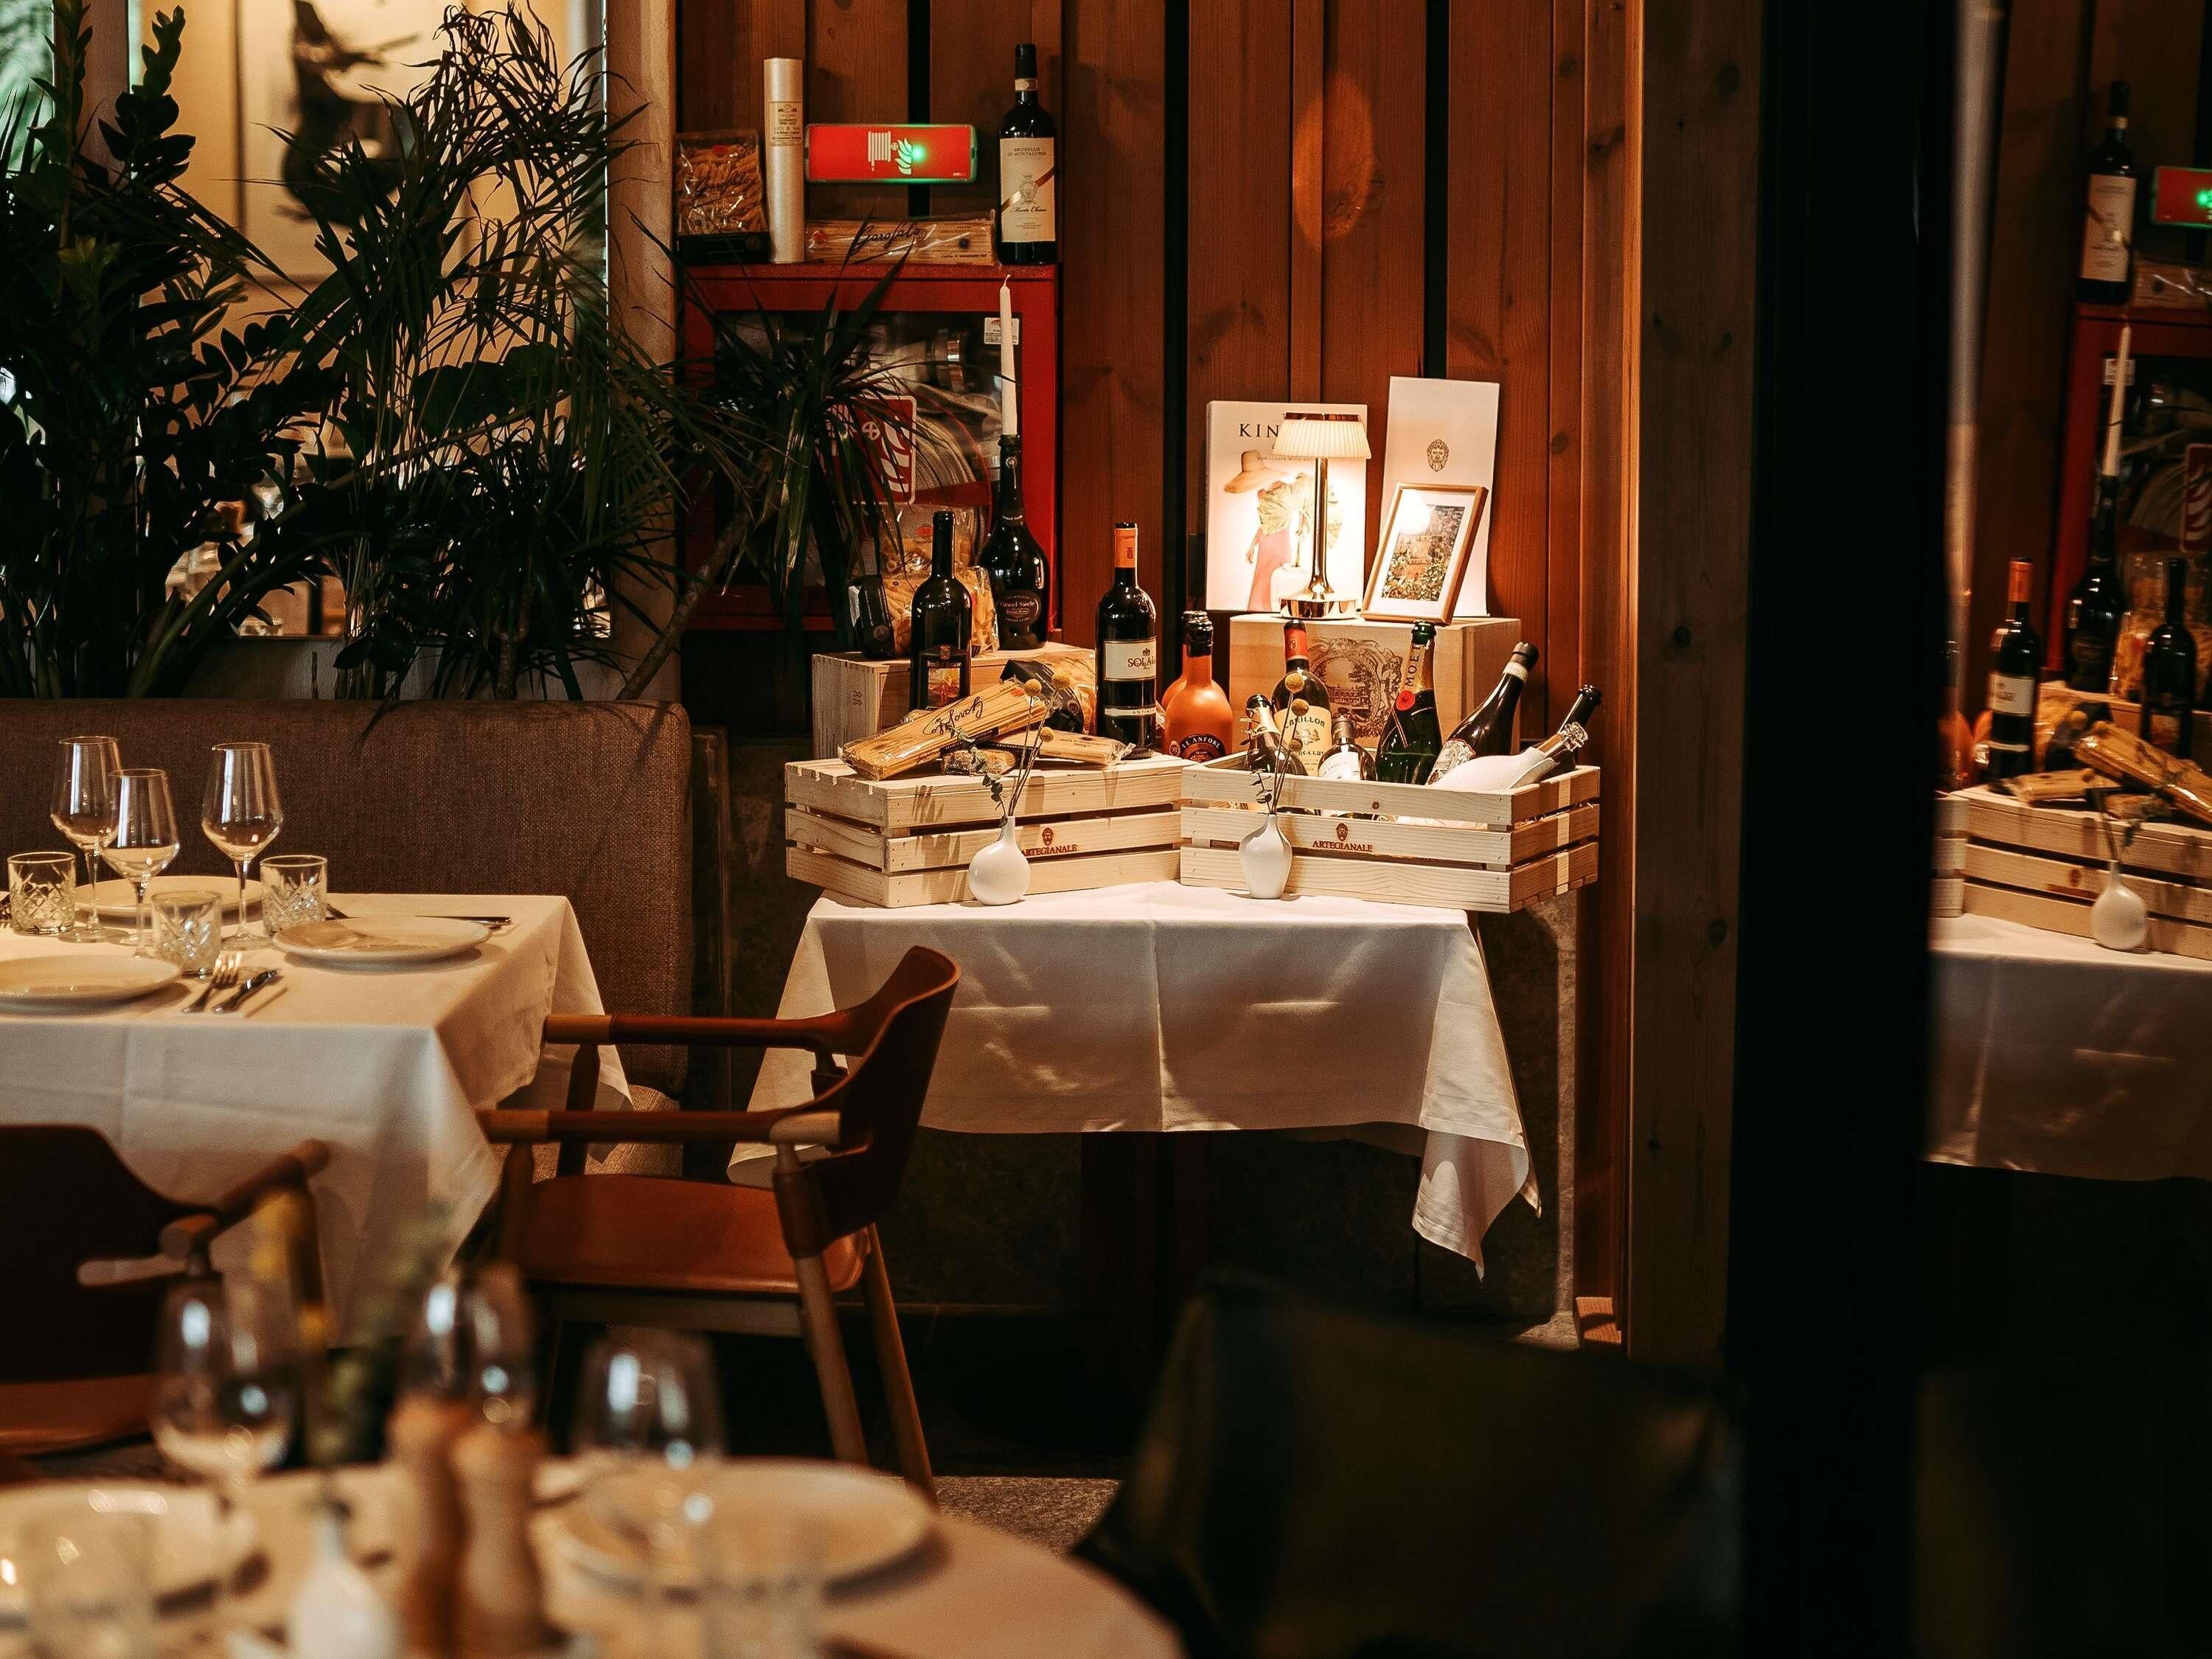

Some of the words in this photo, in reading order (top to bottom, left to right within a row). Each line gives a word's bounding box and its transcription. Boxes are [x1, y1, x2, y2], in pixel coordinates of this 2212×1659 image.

[1239, 423, 1279, 437] KIN
[1021, 844, 1078, 857] ARTEGIANALE
[1312, 840, 1374, 852] ARTEGIANALE
